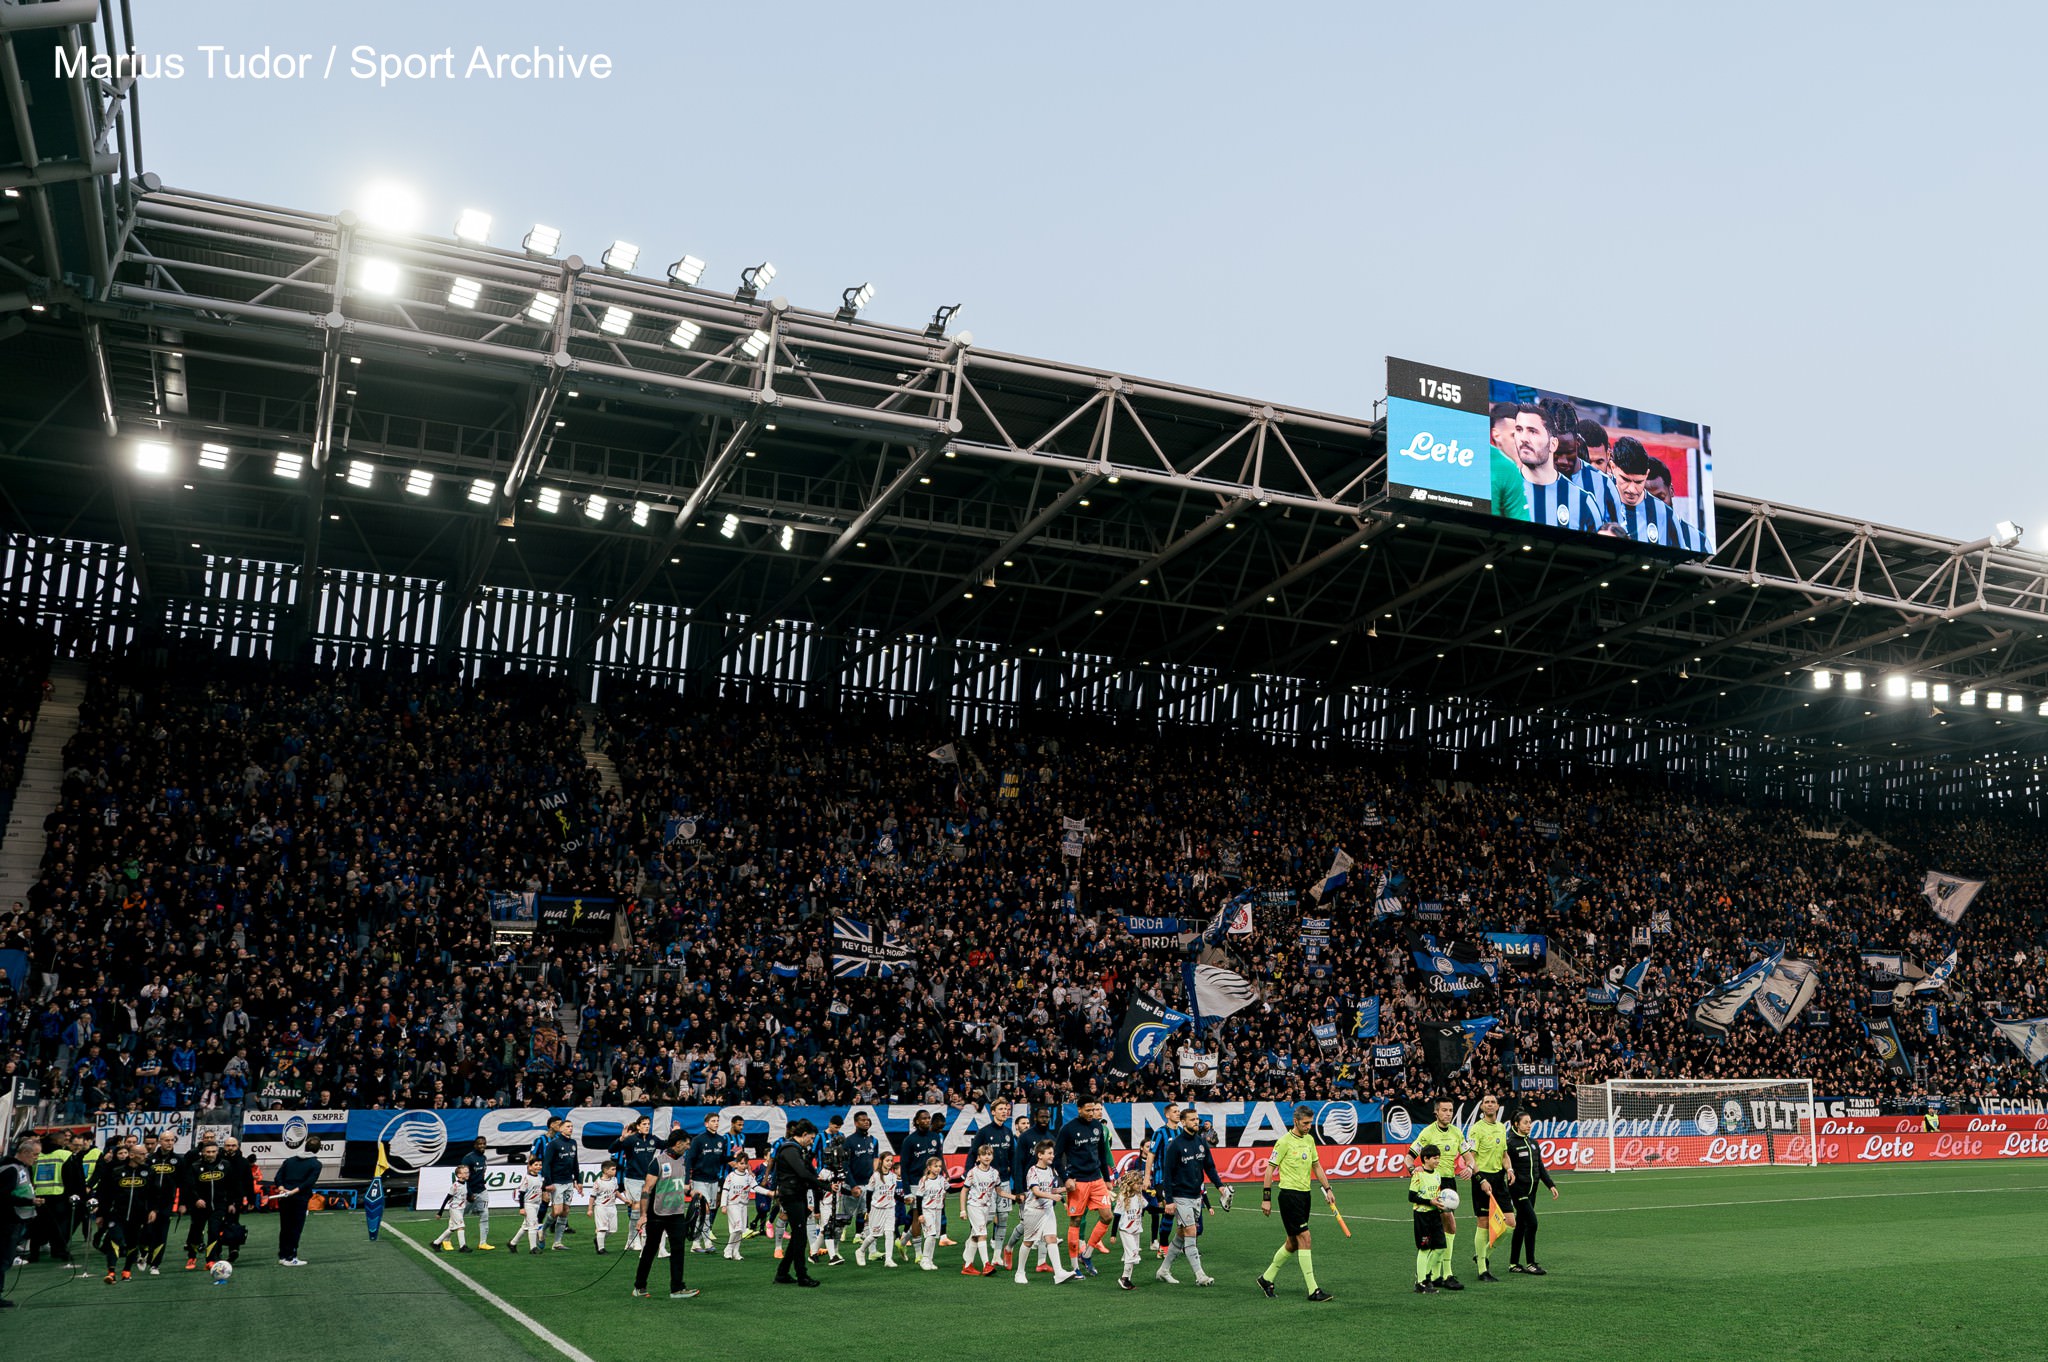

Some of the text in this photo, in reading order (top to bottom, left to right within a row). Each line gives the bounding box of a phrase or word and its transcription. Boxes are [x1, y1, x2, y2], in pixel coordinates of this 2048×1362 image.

[1418, 377, 1462, 404] 17:55
[1399, 431, 1475, 468] Lete
[1427, 494, 1438, 502] new
[1438, 494, 1458, 505] balance
[1458, 498, 1473, 507] arena
[538, 792, 568, 810] MAI
[543, 908, 611, 920] mai sola
[841, 941, 860, 951] KEY
[861, 945, 873, 954] DE
[874, 946, 886, 956] LA
[1538, 1065, 1553, 1075] CHI
[261, 1089, 302, 1097] PASALIC
[1849, 1098, 1875, 1108] TANTO
[1978, 1097, 2044, 1115] VECCHIA
[97, 1111, 182, 1127] BENVENUTO
[312, 1113, 345, 1121] SEMPRE
[1846, 1108, 1880, 1117] TORNANO
[1700, 1137, 1763, 1164] Lete
[1857, 1135, 1914, 1161] Lete
[1929, 1133, 1983, 1158] Lete
[1999, 1132, 2048, 1156] Lete
[1325, 1146, 1405, 1177] Lete
